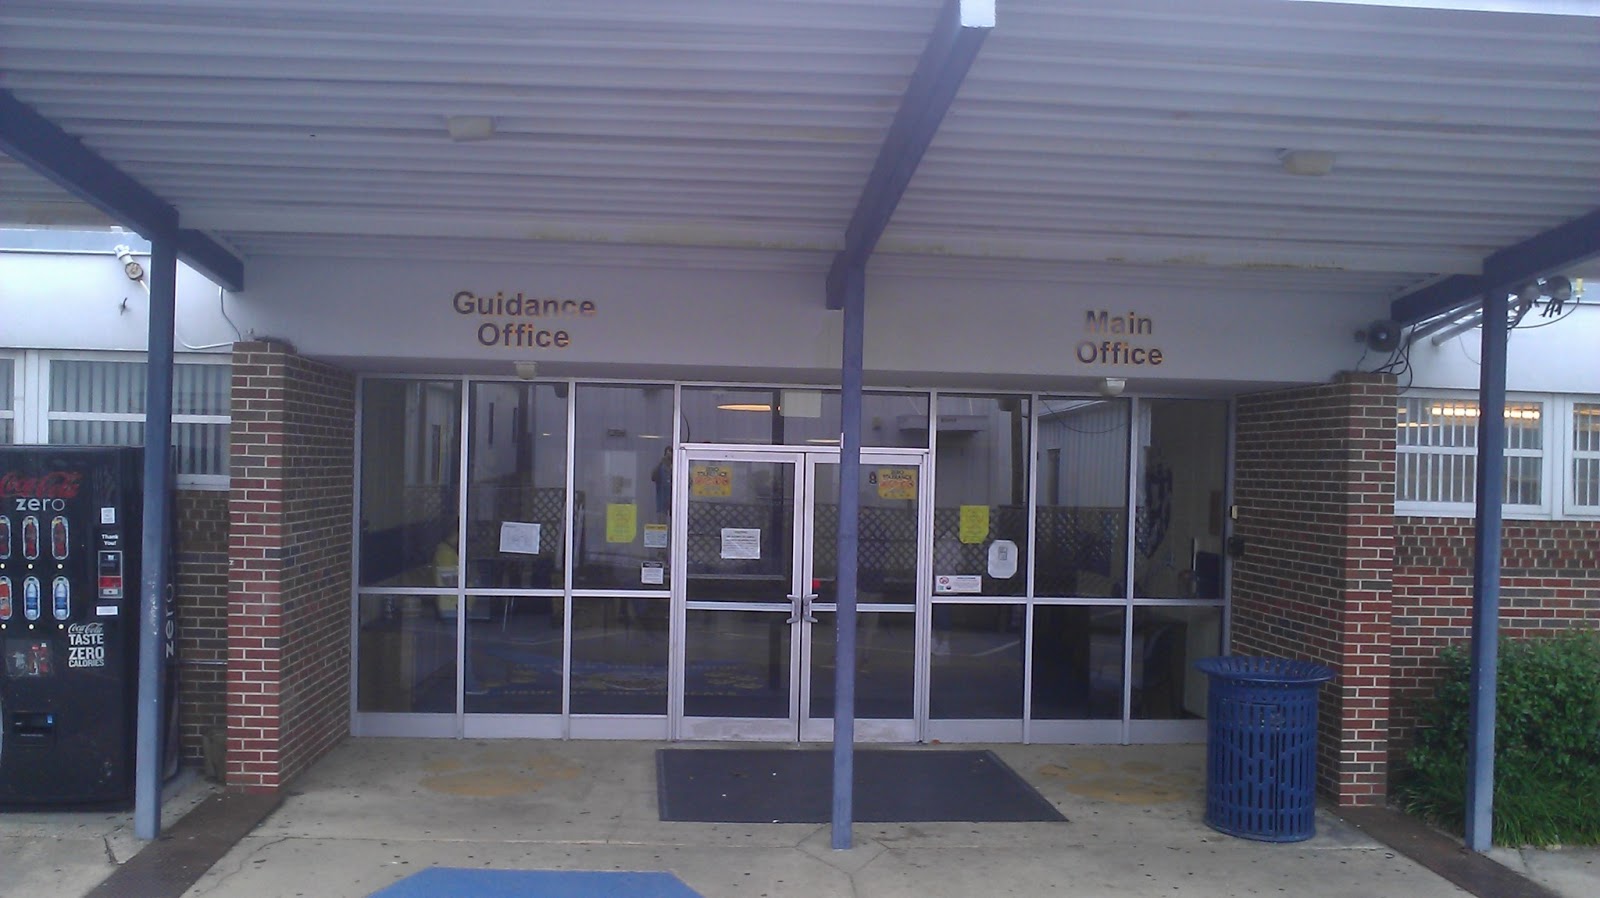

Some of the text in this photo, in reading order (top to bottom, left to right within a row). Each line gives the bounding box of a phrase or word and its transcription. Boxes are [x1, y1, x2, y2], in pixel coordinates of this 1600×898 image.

[453, 290, 596, 317] Guidance
[1086, 310, 1153, 335] Main
[477, 322, 570, 348] Office
[1076, 340, 1164, 366] Office
[15, 498, 65, 512] zero
[68, 633, 104, 645] TASTE
[68, 646, 105, 660] ZERO
[68, 660, 105, 668] CALORIES
